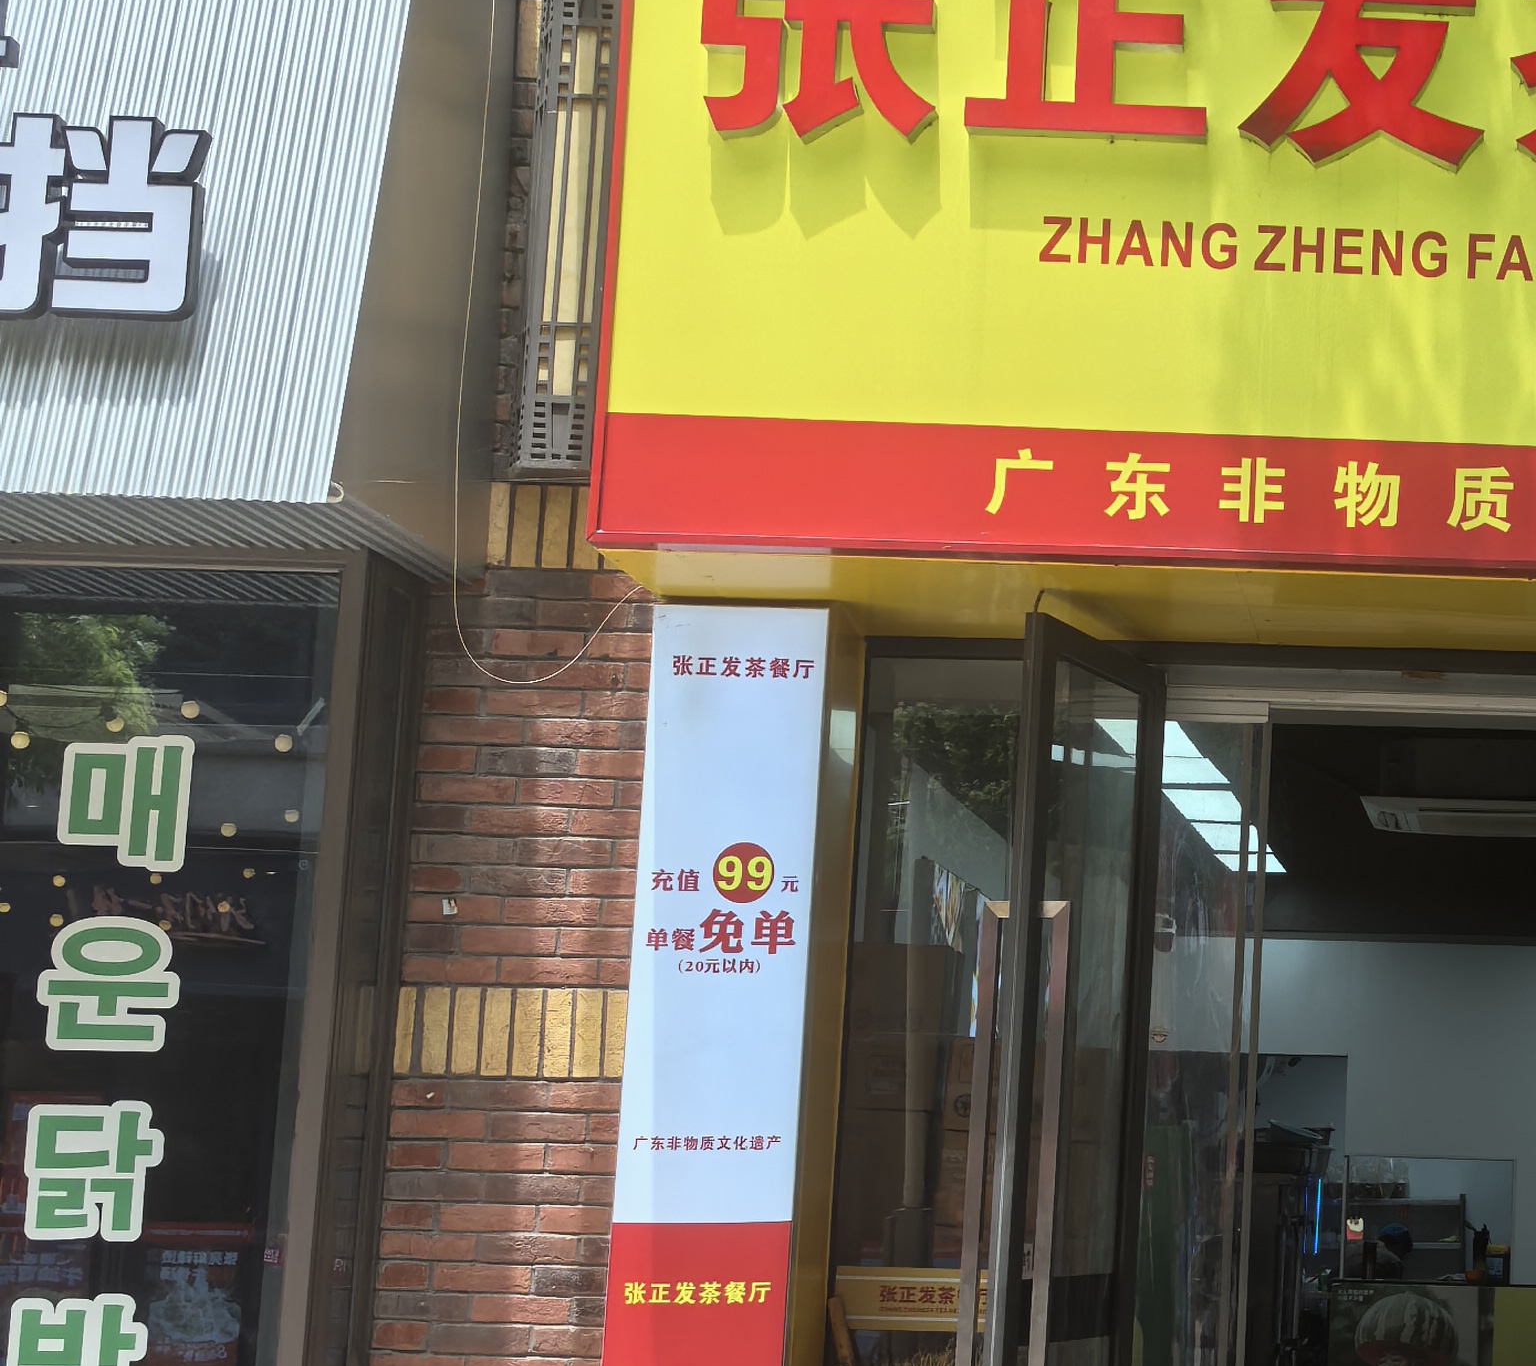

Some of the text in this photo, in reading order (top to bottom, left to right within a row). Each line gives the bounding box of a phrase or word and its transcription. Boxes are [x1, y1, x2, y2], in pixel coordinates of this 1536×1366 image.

[1038, 215, 1239, 271] ZHANG
[1253, 223, 1448, 279] ZHENG
[1466, 233, 1536, 282] FA
[671, 654, 815, 680] 张正发茶餐厅
[633, 1135, 782, 1152] 广东非物质文化遗产
[624, 1280, 772, 1306] 张正发茶餐厅
